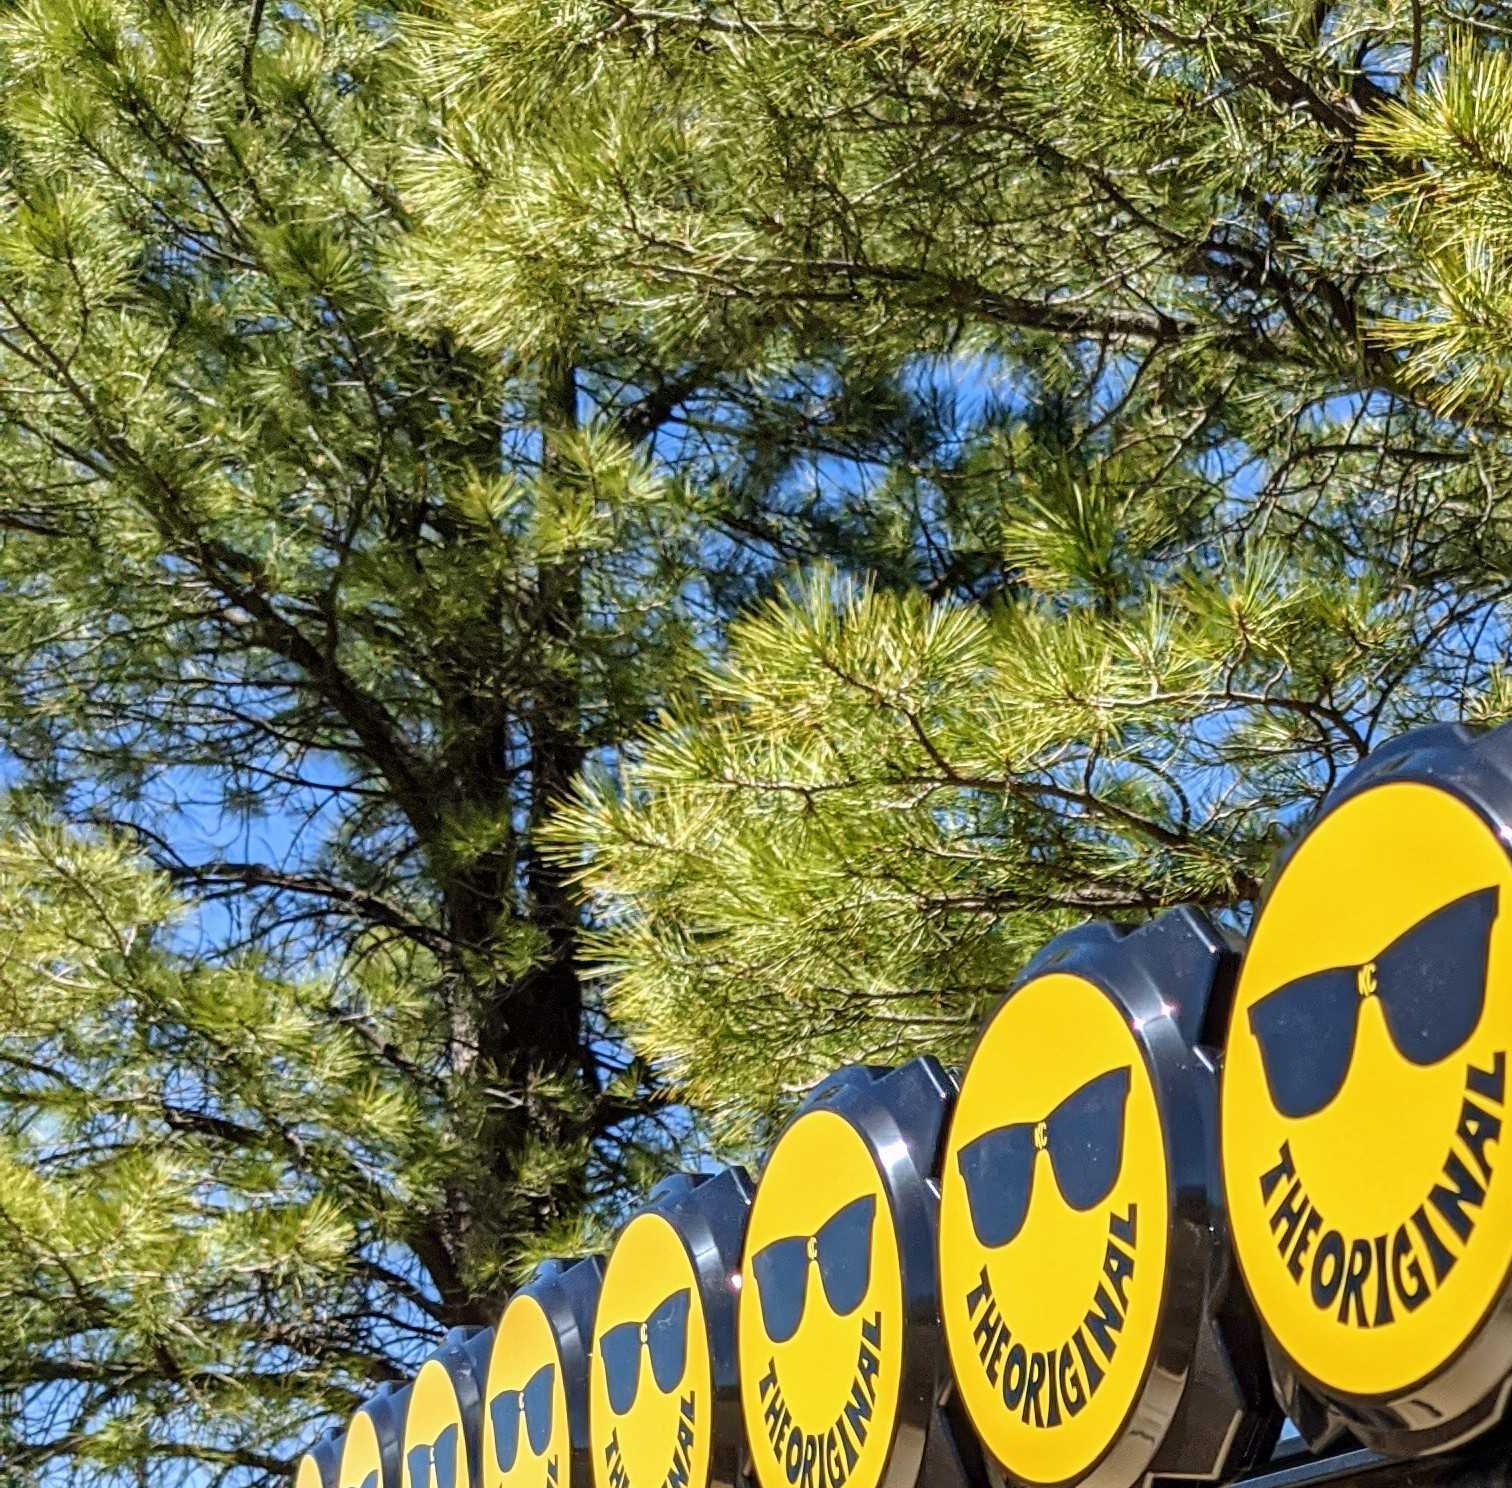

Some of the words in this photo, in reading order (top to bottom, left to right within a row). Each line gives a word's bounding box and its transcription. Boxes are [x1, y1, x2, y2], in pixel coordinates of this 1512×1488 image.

[1357, 963, 1377, 996] KC
[1259, 1139, 1324, 1285] THE
[1311, 1051, 1507, 1328] ORIGINAL
[965, 1264, 1011, 1386] THE
[1003, 1203, 1138, 1428] ORIGINAL
[759, 1357, 791, 1466] THE
